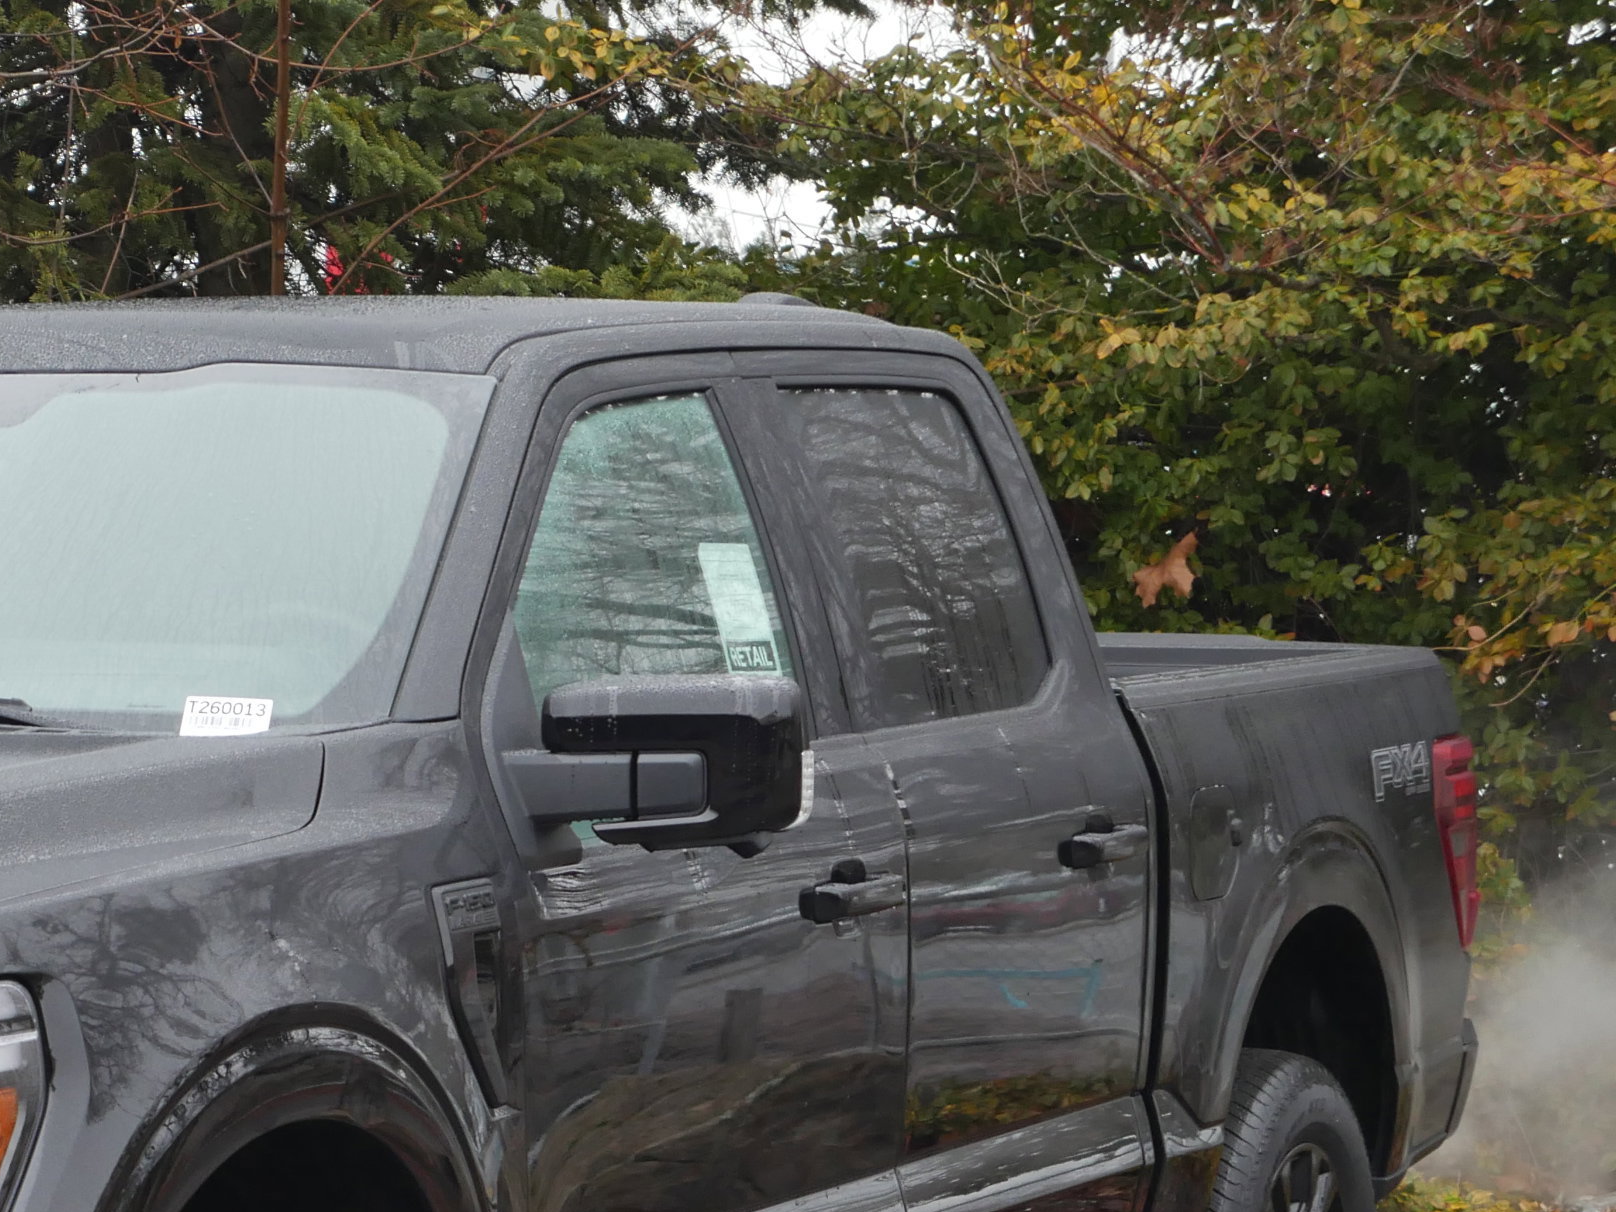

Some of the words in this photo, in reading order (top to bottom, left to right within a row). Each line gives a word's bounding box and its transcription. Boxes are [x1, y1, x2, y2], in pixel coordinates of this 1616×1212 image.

[728, 645, 774, 667] RETAIL
[188, 700, 266, 717] T260013
[1371, 740, 1430, 803] FX4
